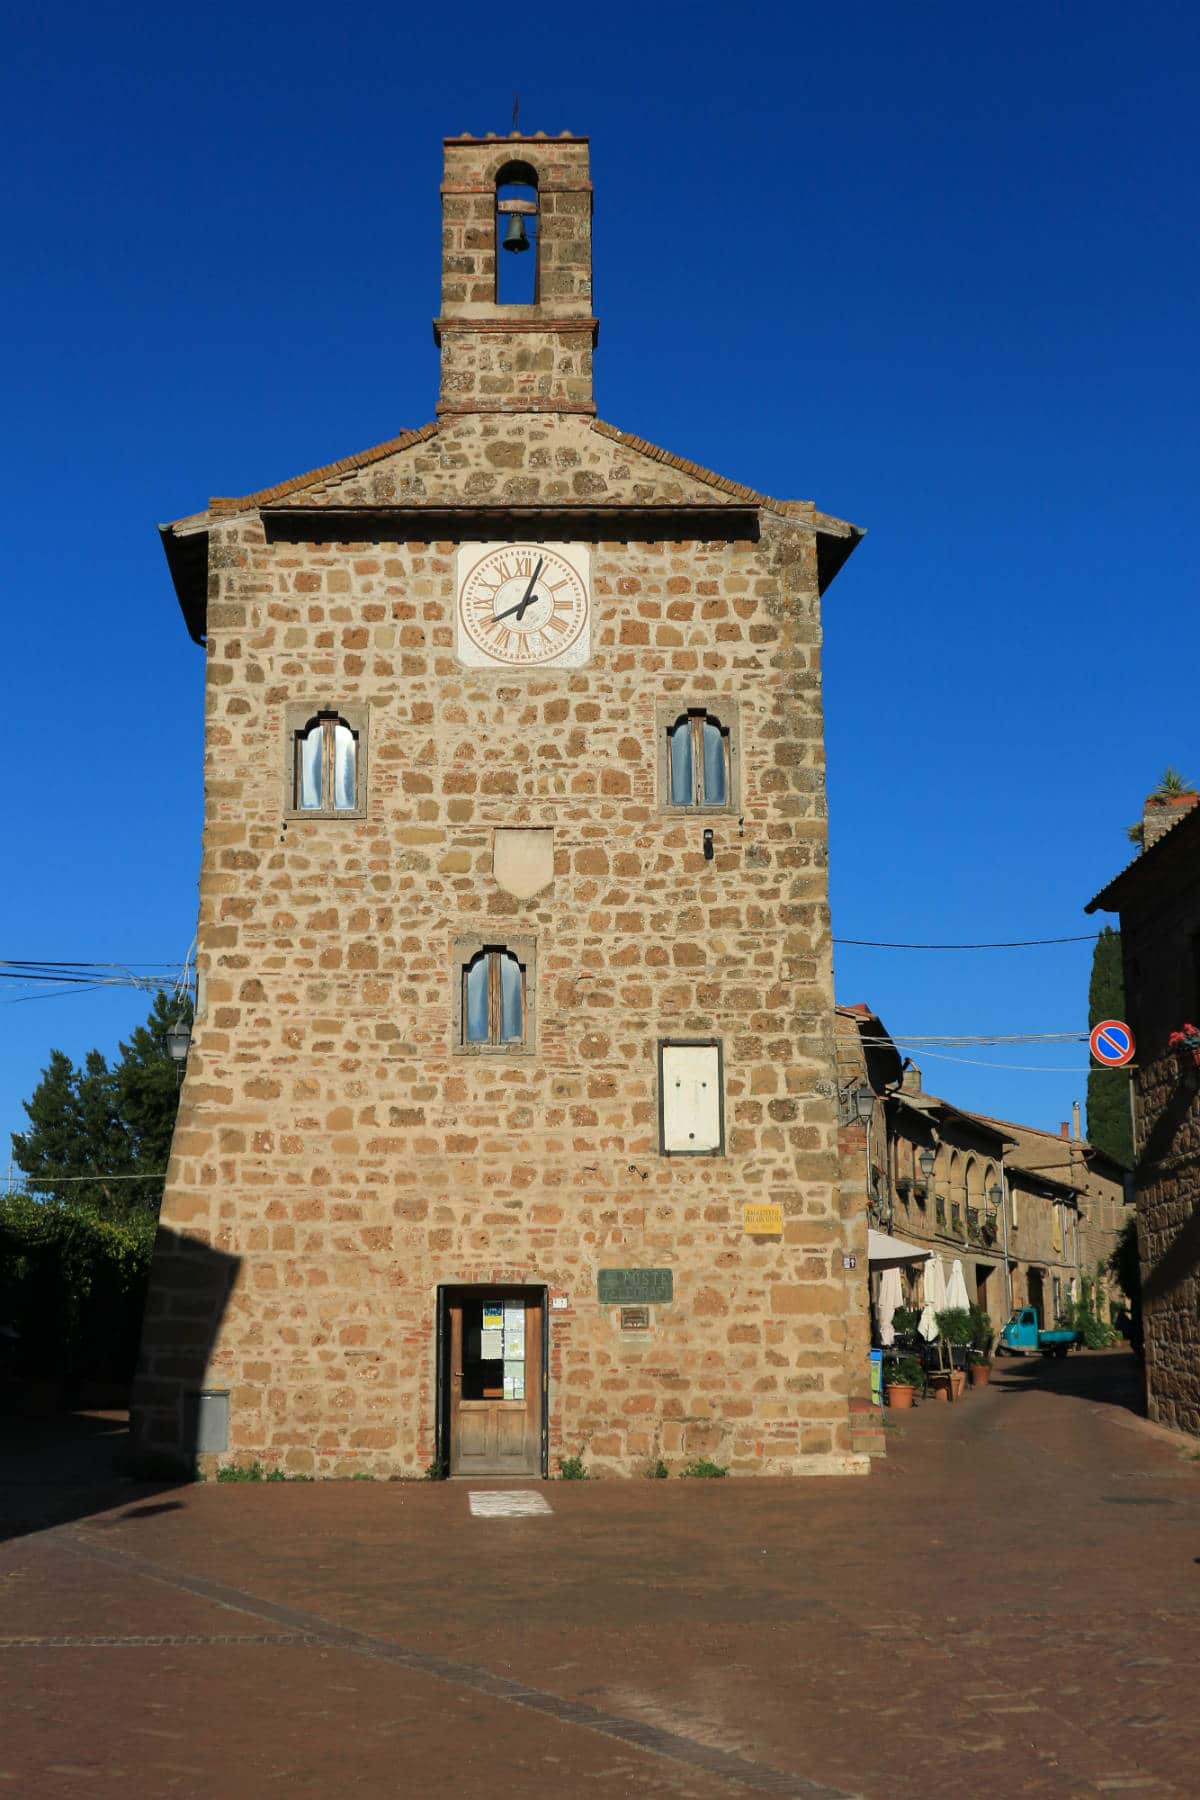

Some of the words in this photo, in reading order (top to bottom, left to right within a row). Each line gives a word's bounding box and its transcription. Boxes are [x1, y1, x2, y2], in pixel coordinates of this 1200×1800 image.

[515, 557, 532, 577] XII
[477, 578, 498, 592] X
[549, 578, 569, 593] II
[554, 600, 573, 610] III
